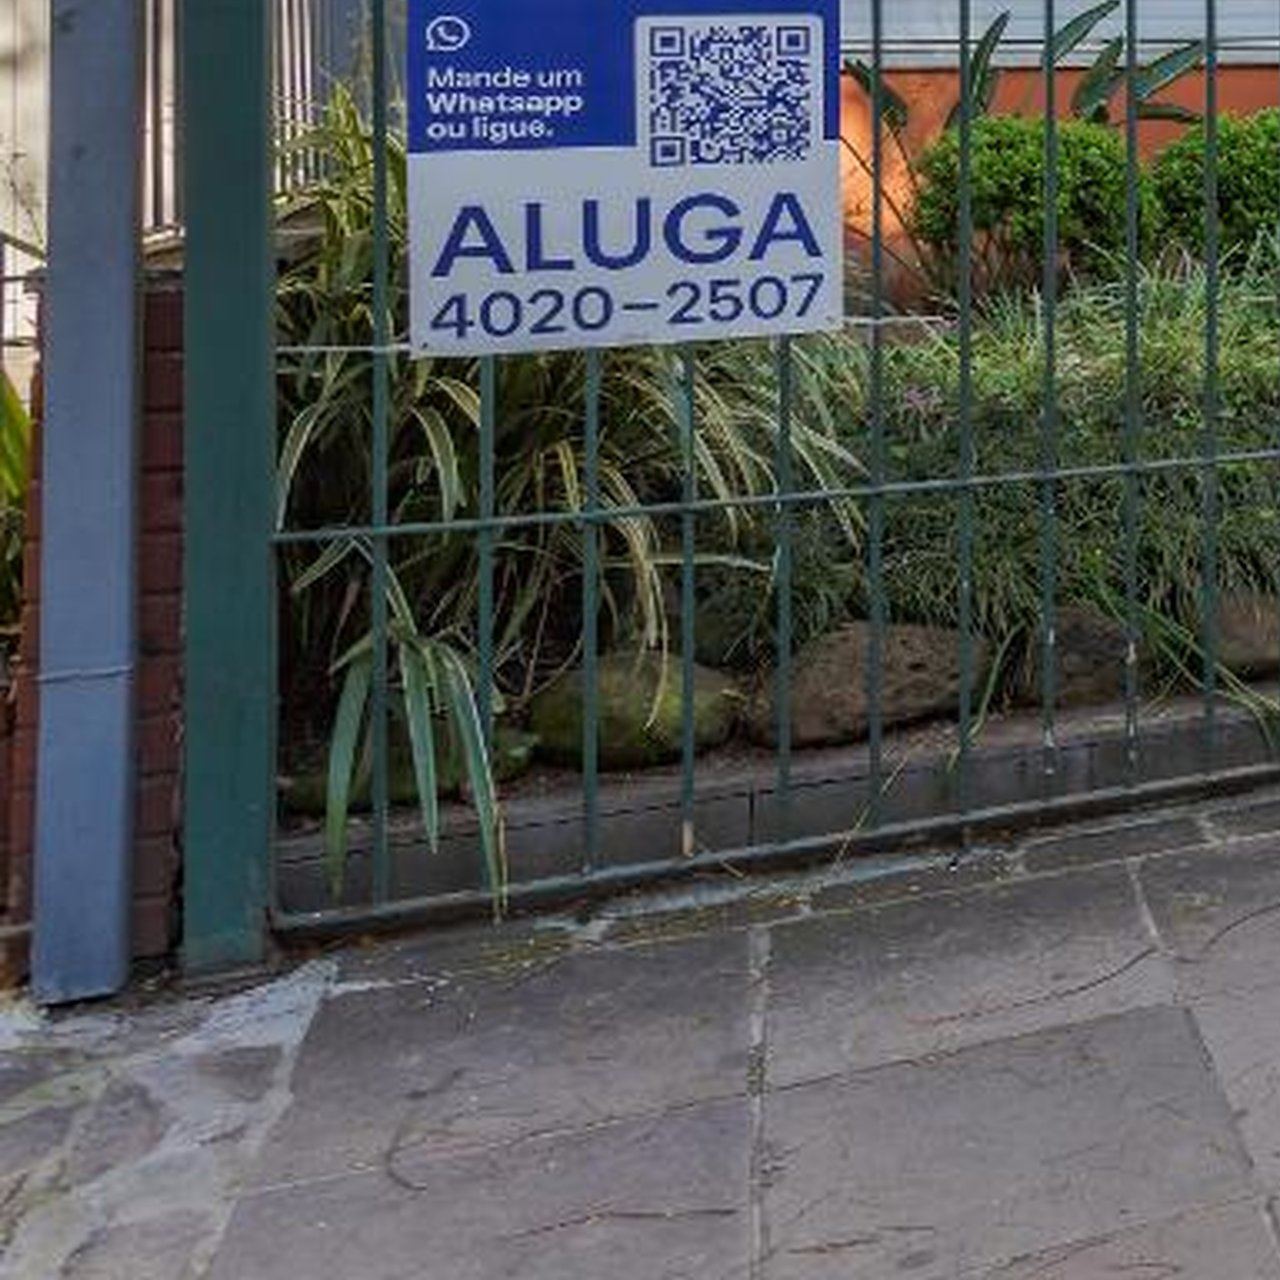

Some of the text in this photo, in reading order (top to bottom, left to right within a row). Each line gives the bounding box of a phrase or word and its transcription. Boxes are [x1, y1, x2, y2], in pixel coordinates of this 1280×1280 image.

[427, 67, 583, 88] Mande um
[426, 92, 584, 117] Whatsapp
[427, 116, 554, 145] ou ligue.
[431, 191, 824, 278] ALUGA
[430, 273, 825, 339] 4020-2507
